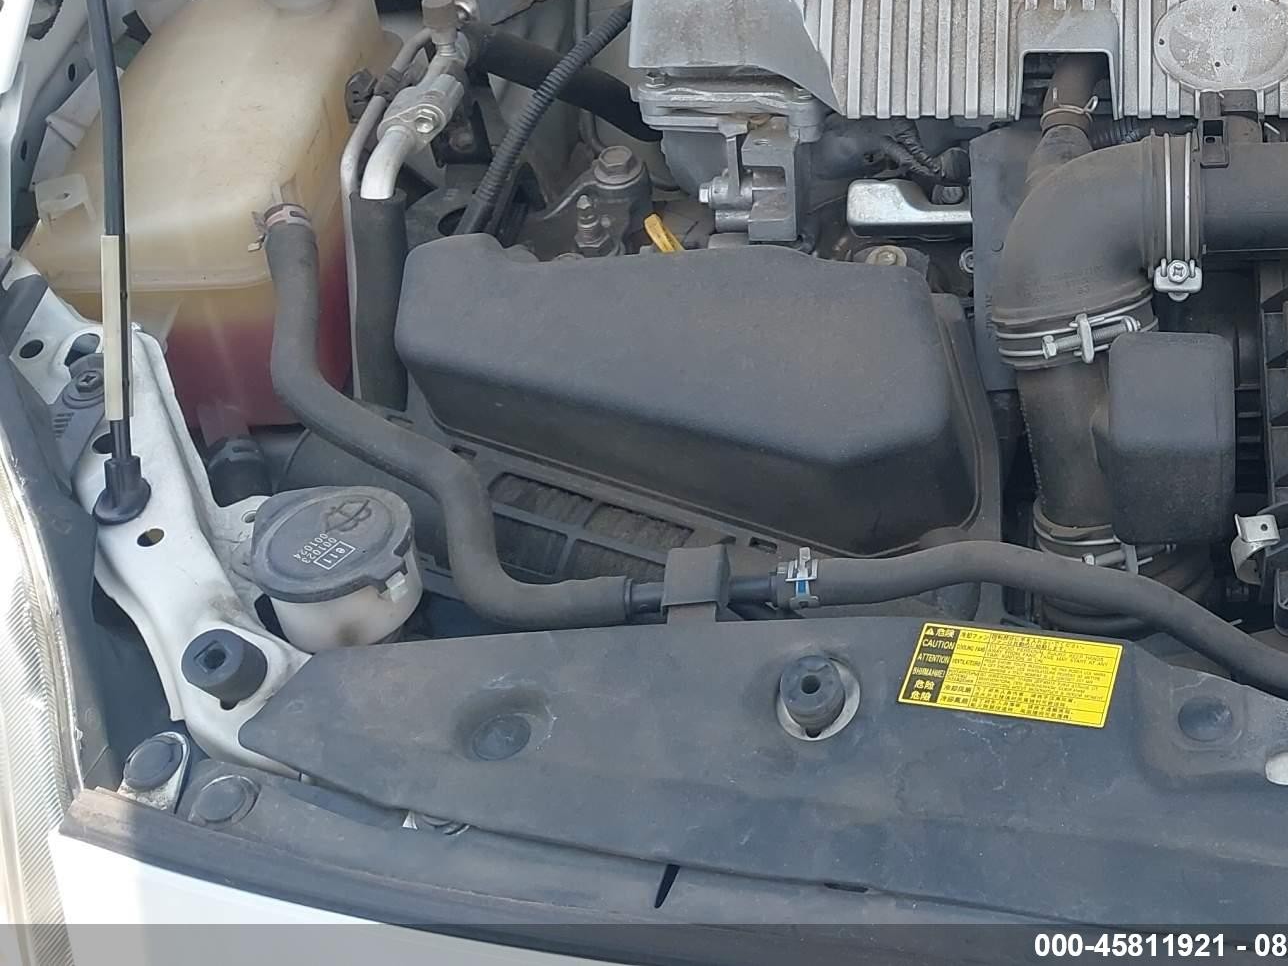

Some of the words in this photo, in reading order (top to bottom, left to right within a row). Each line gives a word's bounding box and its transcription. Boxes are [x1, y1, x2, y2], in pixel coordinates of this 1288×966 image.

[301, 537, 337, 564] 001023
[922, 639, 955, 650] CAUTION
[917, 653, 951, 664] ATTENTION
